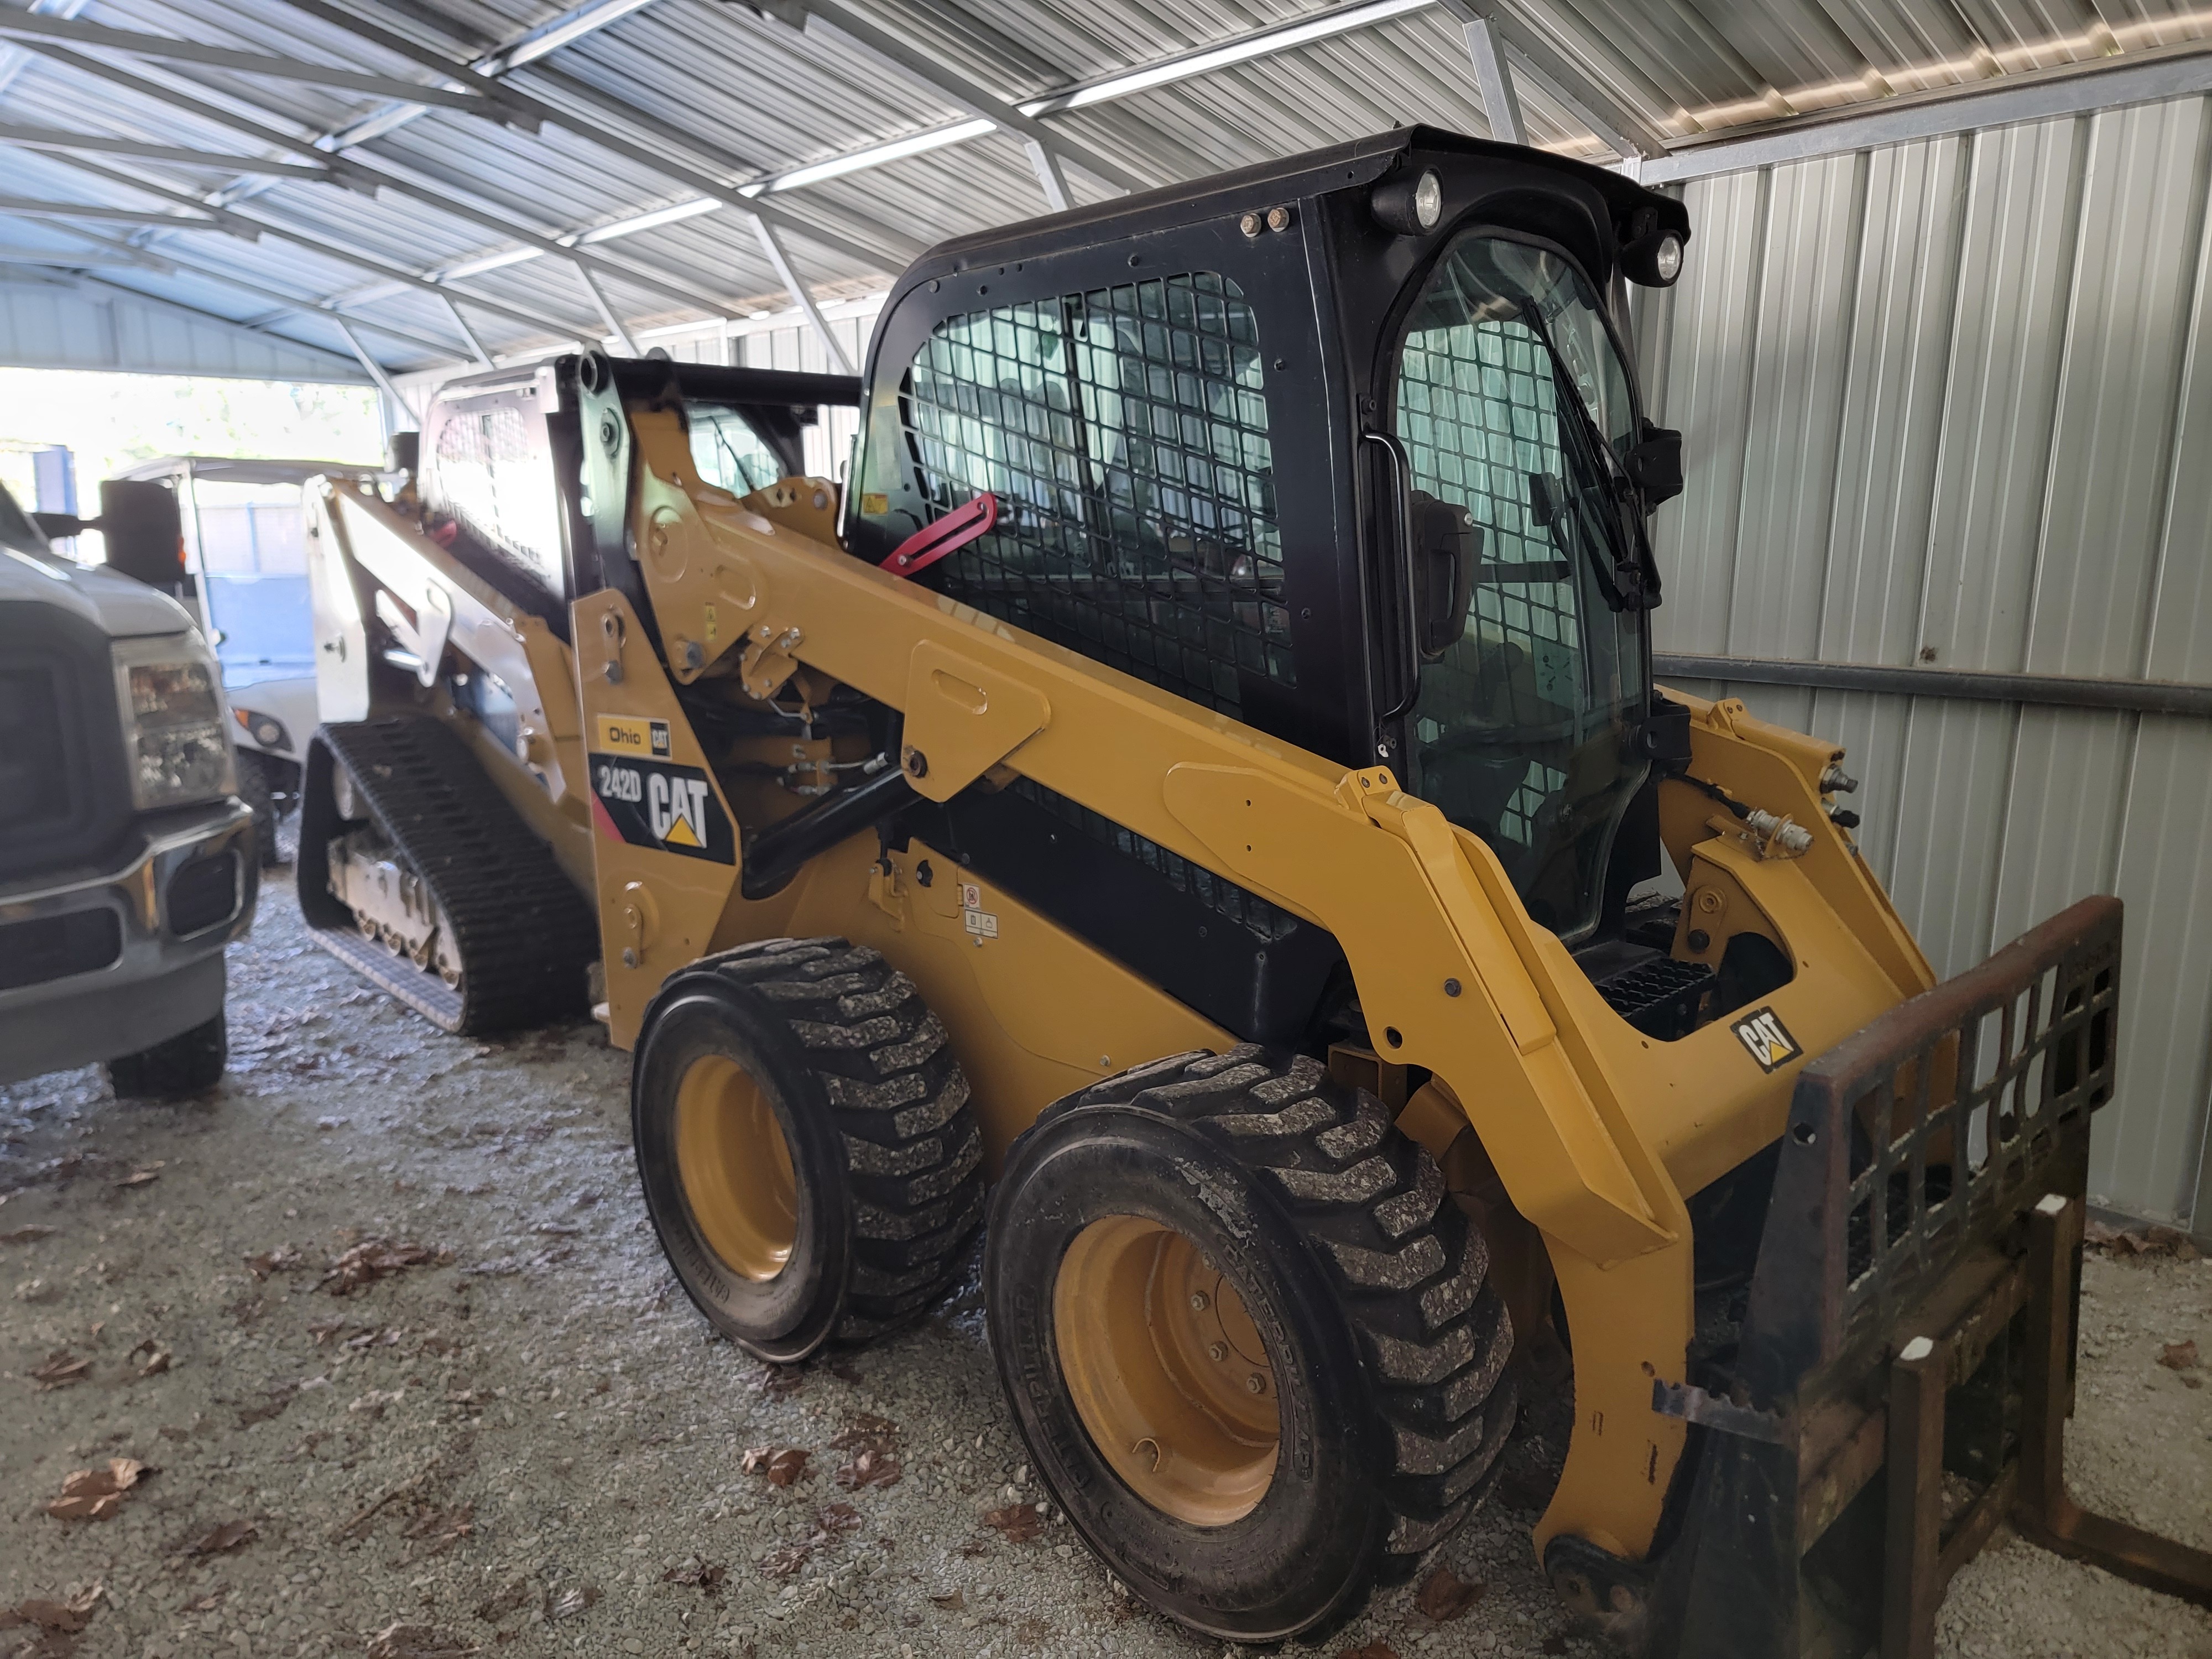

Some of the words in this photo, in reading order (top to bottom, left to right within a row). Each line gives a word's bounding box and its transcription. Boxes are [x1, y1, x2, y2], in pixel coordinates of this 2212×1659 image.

[609, 726, 641, 745] Ohio
[651, 729, 668, 749] CAT
[599, 765, 642, 803] 242D
[647, 773, 708, 849] CAT
[1739, 1012, 1794, 1066] CAT
